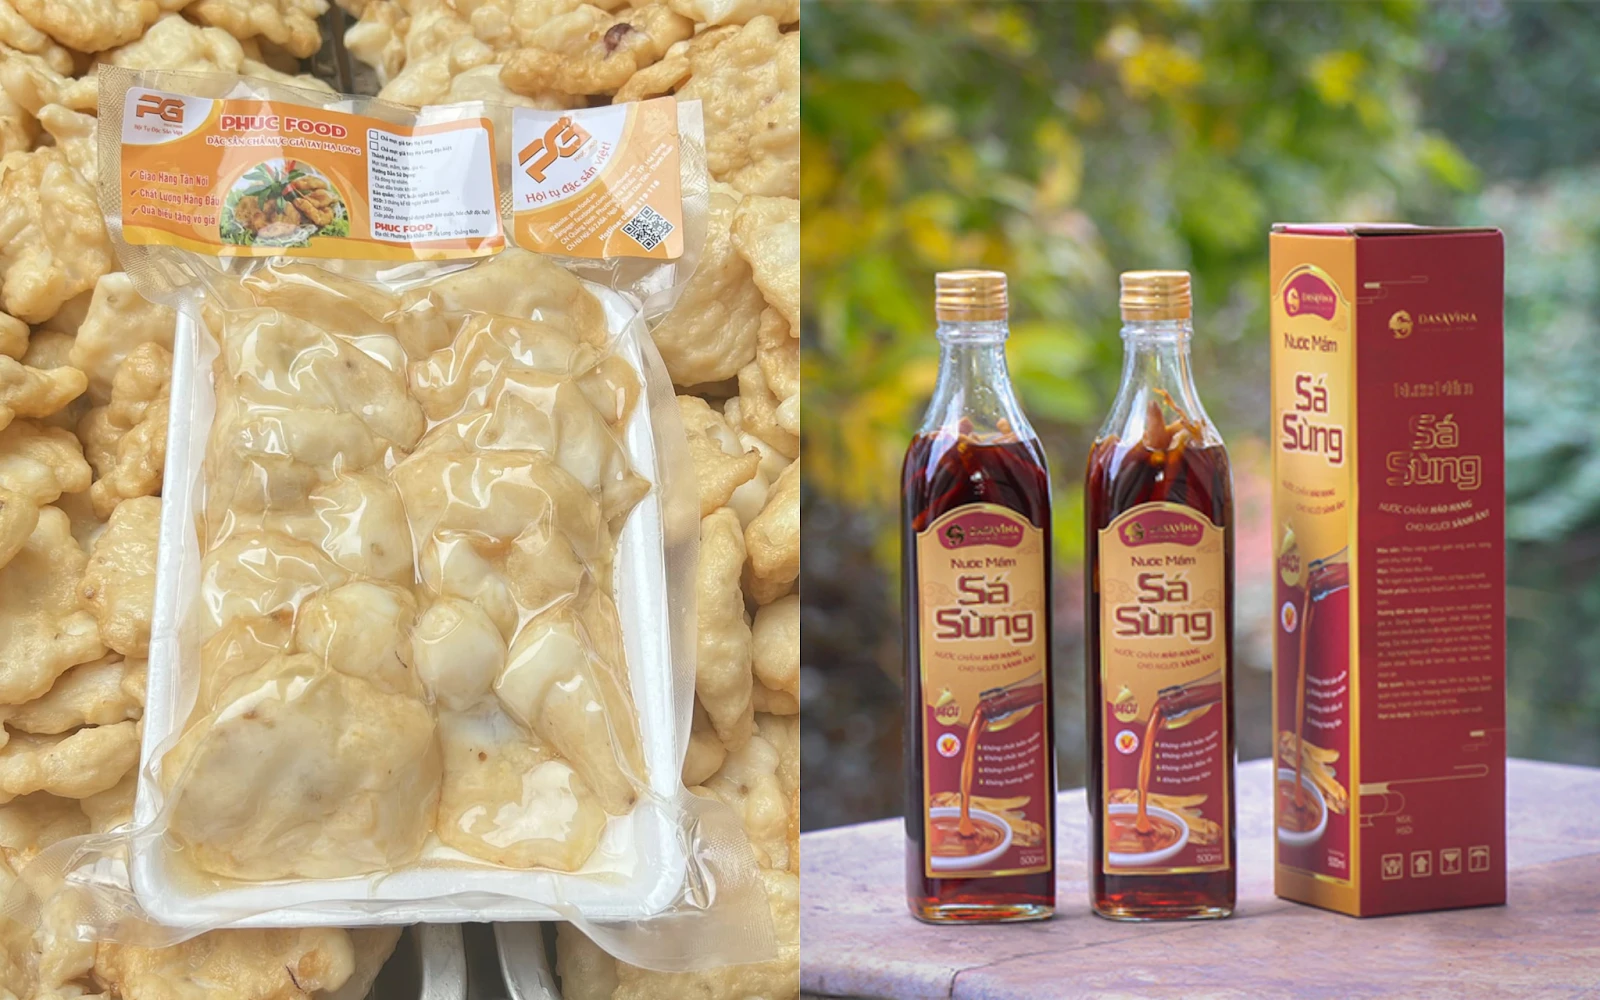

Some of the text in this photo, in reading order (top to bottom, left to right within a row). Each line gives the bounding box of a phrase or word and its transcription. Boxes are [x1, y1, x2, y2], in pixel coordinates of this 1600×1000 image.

[285, 117, 347, 138] FOOD
[307, 139, 322, 150] TAY
[338, 144, 361, 156] LONG
[140, 170, 156, 182] Giao
[550, 188, 560, 199] tụ
[561, 180, 581, 194] đặc
[580, 165, 598, 182] sản
[403, 224, 434, 232] FOOD
[599, 219, 622, 240] Hotline:
[1295, 373, 1328, 413] Sá
[1282, 412, 1344, 465] Sùng
[1408, 412, 1460, 451] Sá
[1385, 450, 1482, 491] Sùng
[957, 573, 1010, 606] Sá
[1137, 571, 1190, 604] Sá
[934, 607, 1034, 645] Sùng
[1114, 605, 1214, 642] Sùng
